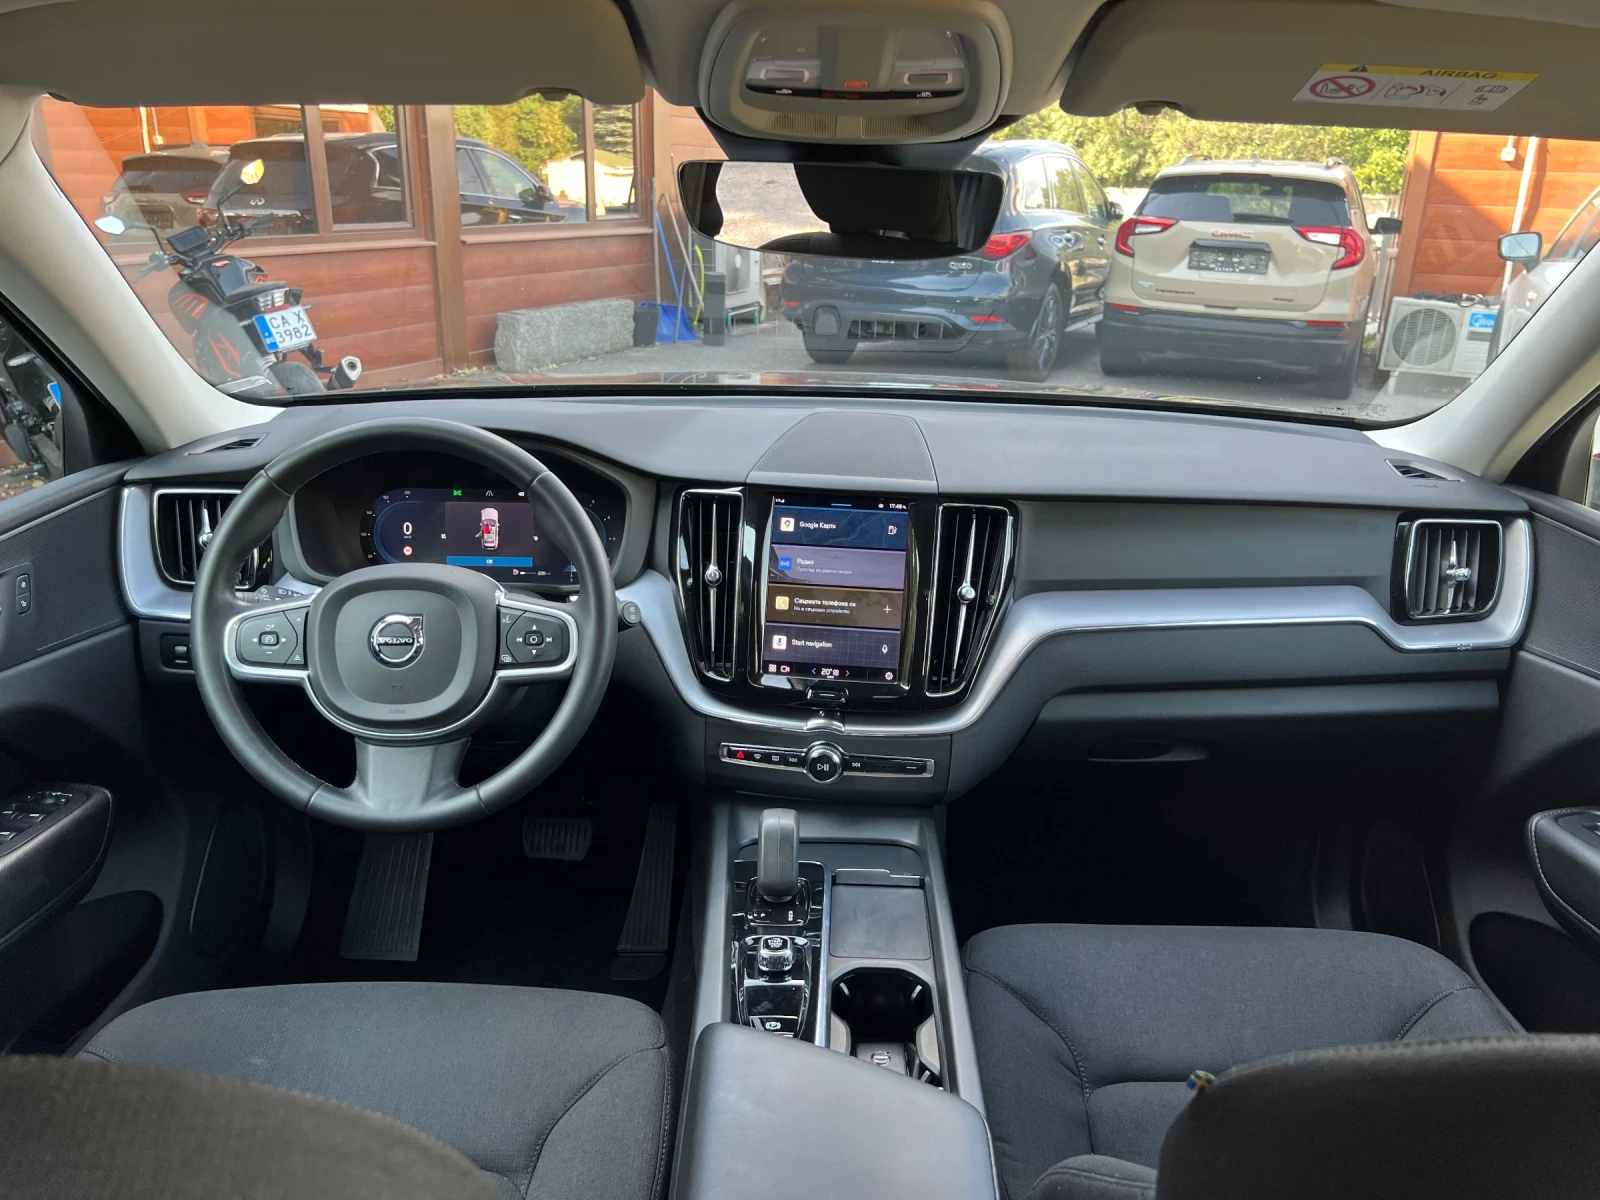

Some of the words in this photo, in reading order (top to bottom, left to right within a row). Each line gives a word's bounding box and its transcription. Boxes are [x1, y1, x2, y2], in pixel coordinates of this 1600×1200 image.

[1419, 69, 1498, 80] AIRBAG
[1211, 228, 1253, 239] GMC
[269, 315, 291, 329] CA
[292, 310, 305, 324] X
[275, 324, 312, 344] 3982
[403, 522, 413, 535] 0
[799, 520, 819, 530] Google
[378, 636, 414, 644] VOLVO
[791, 639, 806, 647] Start
[805, 641, 833, 649] navigation
